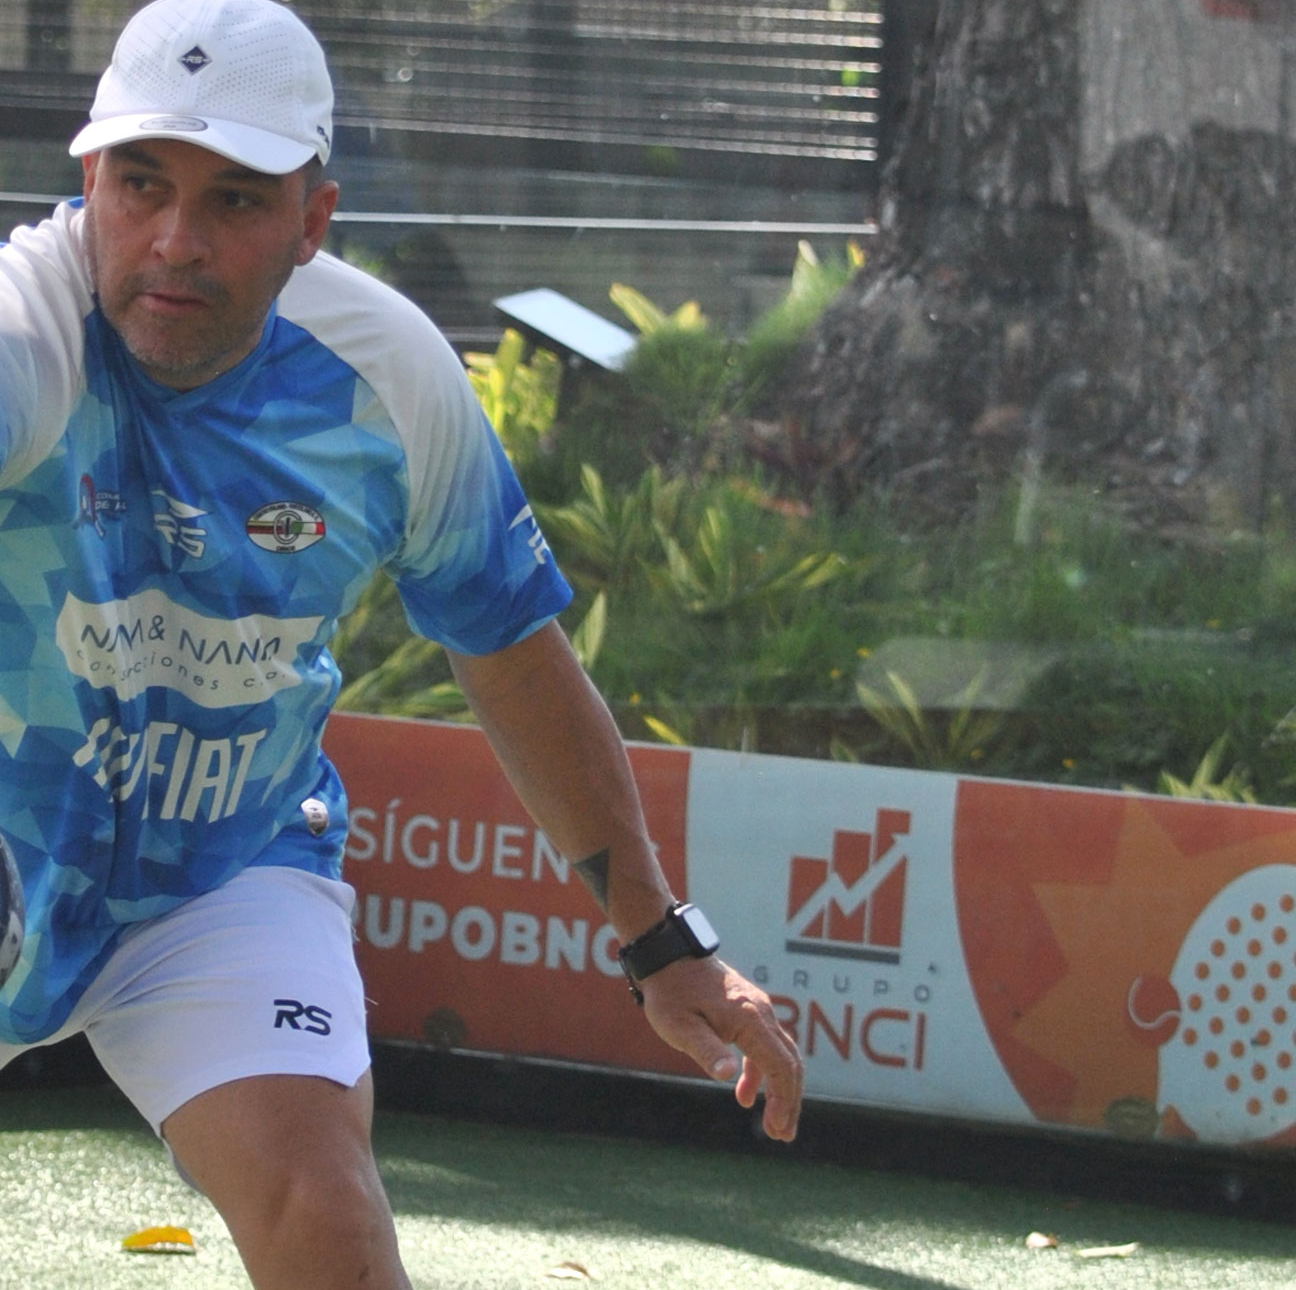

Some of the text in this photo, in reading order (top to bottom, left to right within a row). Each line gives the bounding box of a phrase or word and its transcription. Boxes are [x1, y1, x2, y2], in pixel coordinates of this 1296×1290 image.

[141, 721, 268, 824] FIAT
[346, 799, 573, 885] SÍGUEN
[753, 965, 932, 1004] GRUPO
[273, 998, 333, 1037] RS
